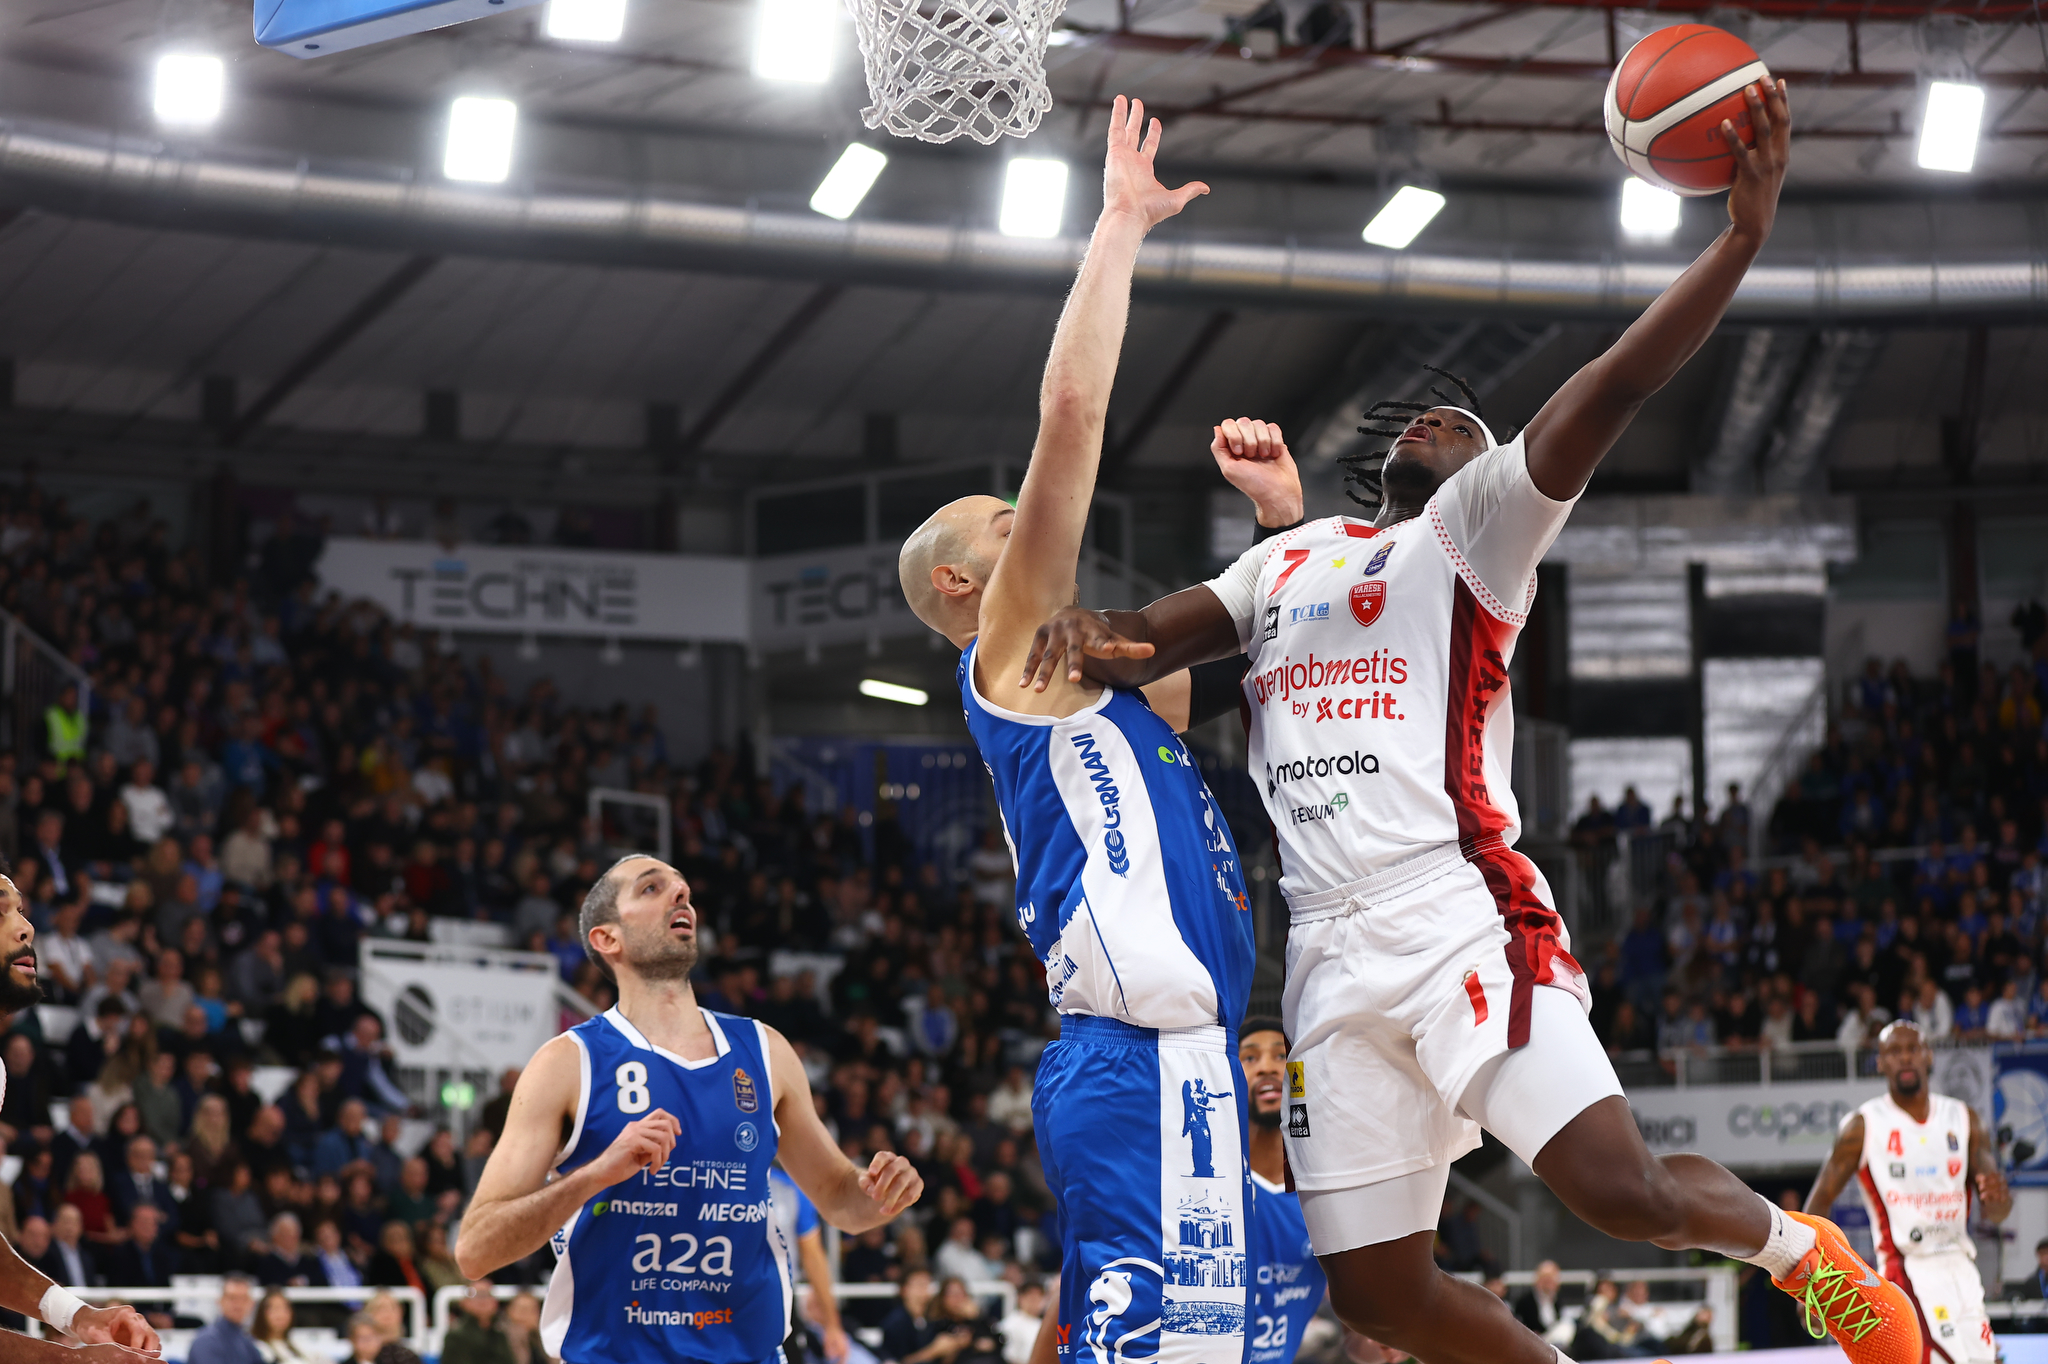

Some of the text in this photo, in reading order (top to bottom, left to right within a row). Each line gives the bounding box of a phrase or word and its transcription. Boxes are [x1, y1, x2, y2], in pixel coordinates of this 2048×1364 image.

[1267, 549, 1310, 598] 7
[391, 560, 635, 623] TECHNE
[764, 566, 903, 626] TECH
[1354, 584, 1382, 593] VARESE
[1290, 604, 1316, 622] TCI
[1263, 628, 1277, 640] rea
[1292, 700, 1310, 718] by
[1276, 750, 1379, 784] motorola
[615, 1061, 650, 1114] 8
[1887, 1129, 1904, 1157] 4
[641, 1163, 746, 1191] TECHNE
[692, 1160, 747, 1170] METROLOGIA
[611, 1200, 678, 1217] mazza
[632, 1232, 733, 1277] a2a
[631, 1278, 731, 1293] LIFE COMPANY
[624, 1301, 733, 1330] Humangest
